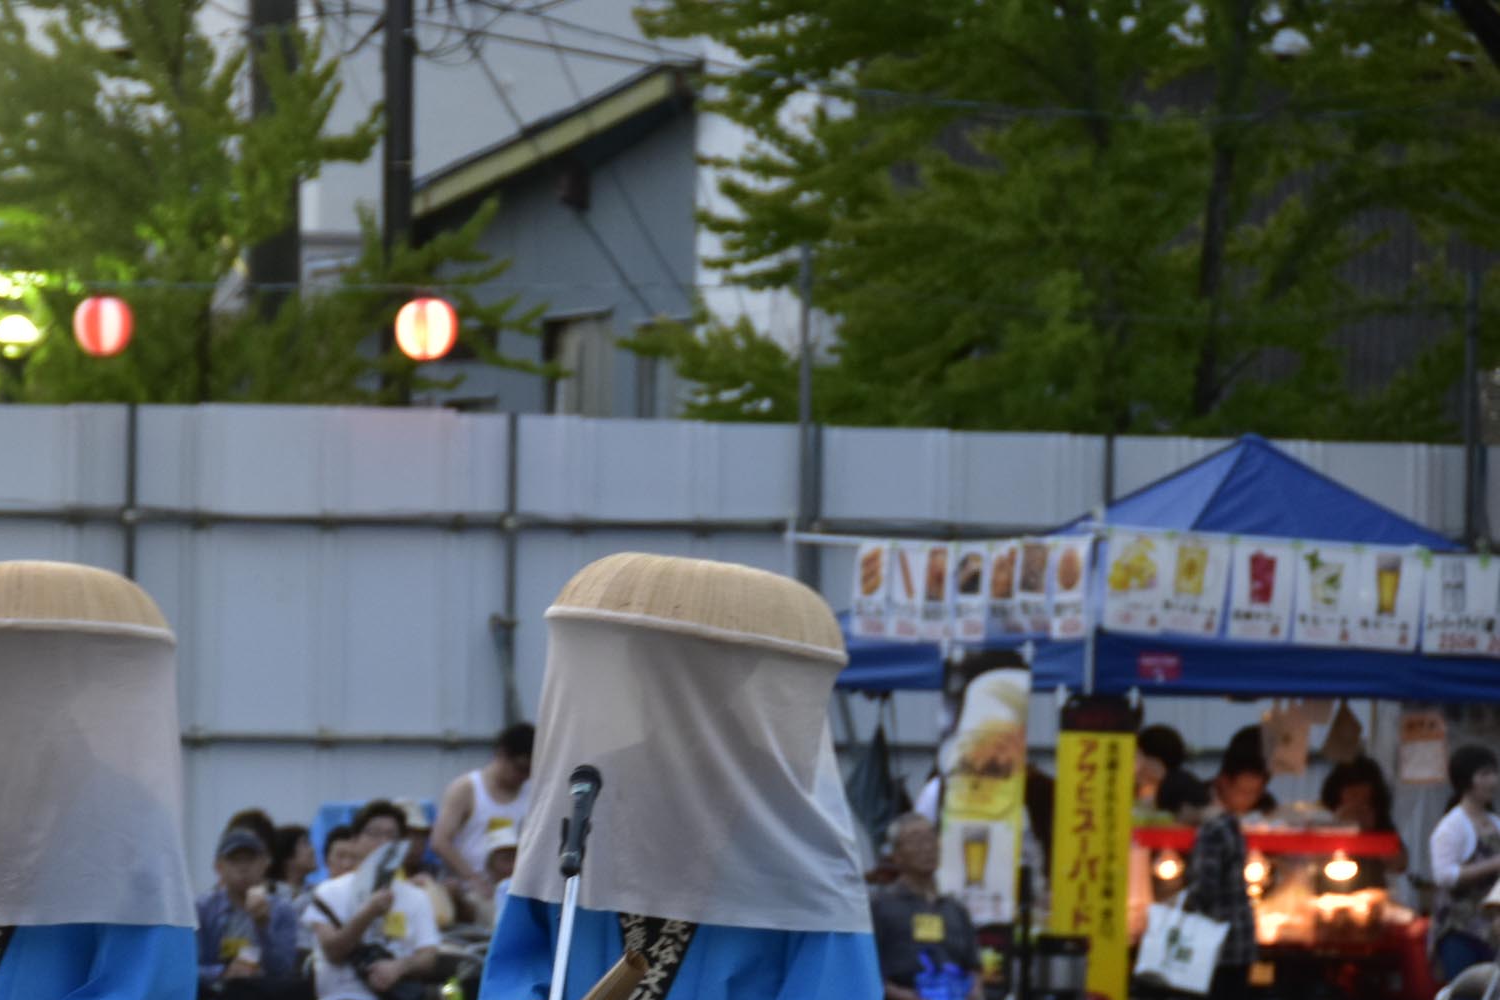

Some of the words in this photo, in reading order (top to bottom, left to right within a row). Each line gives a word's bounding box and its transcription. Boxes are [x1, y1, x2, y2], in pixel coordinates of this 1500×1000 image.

[1068, 738, 1102, 933] アサヒスーパード
